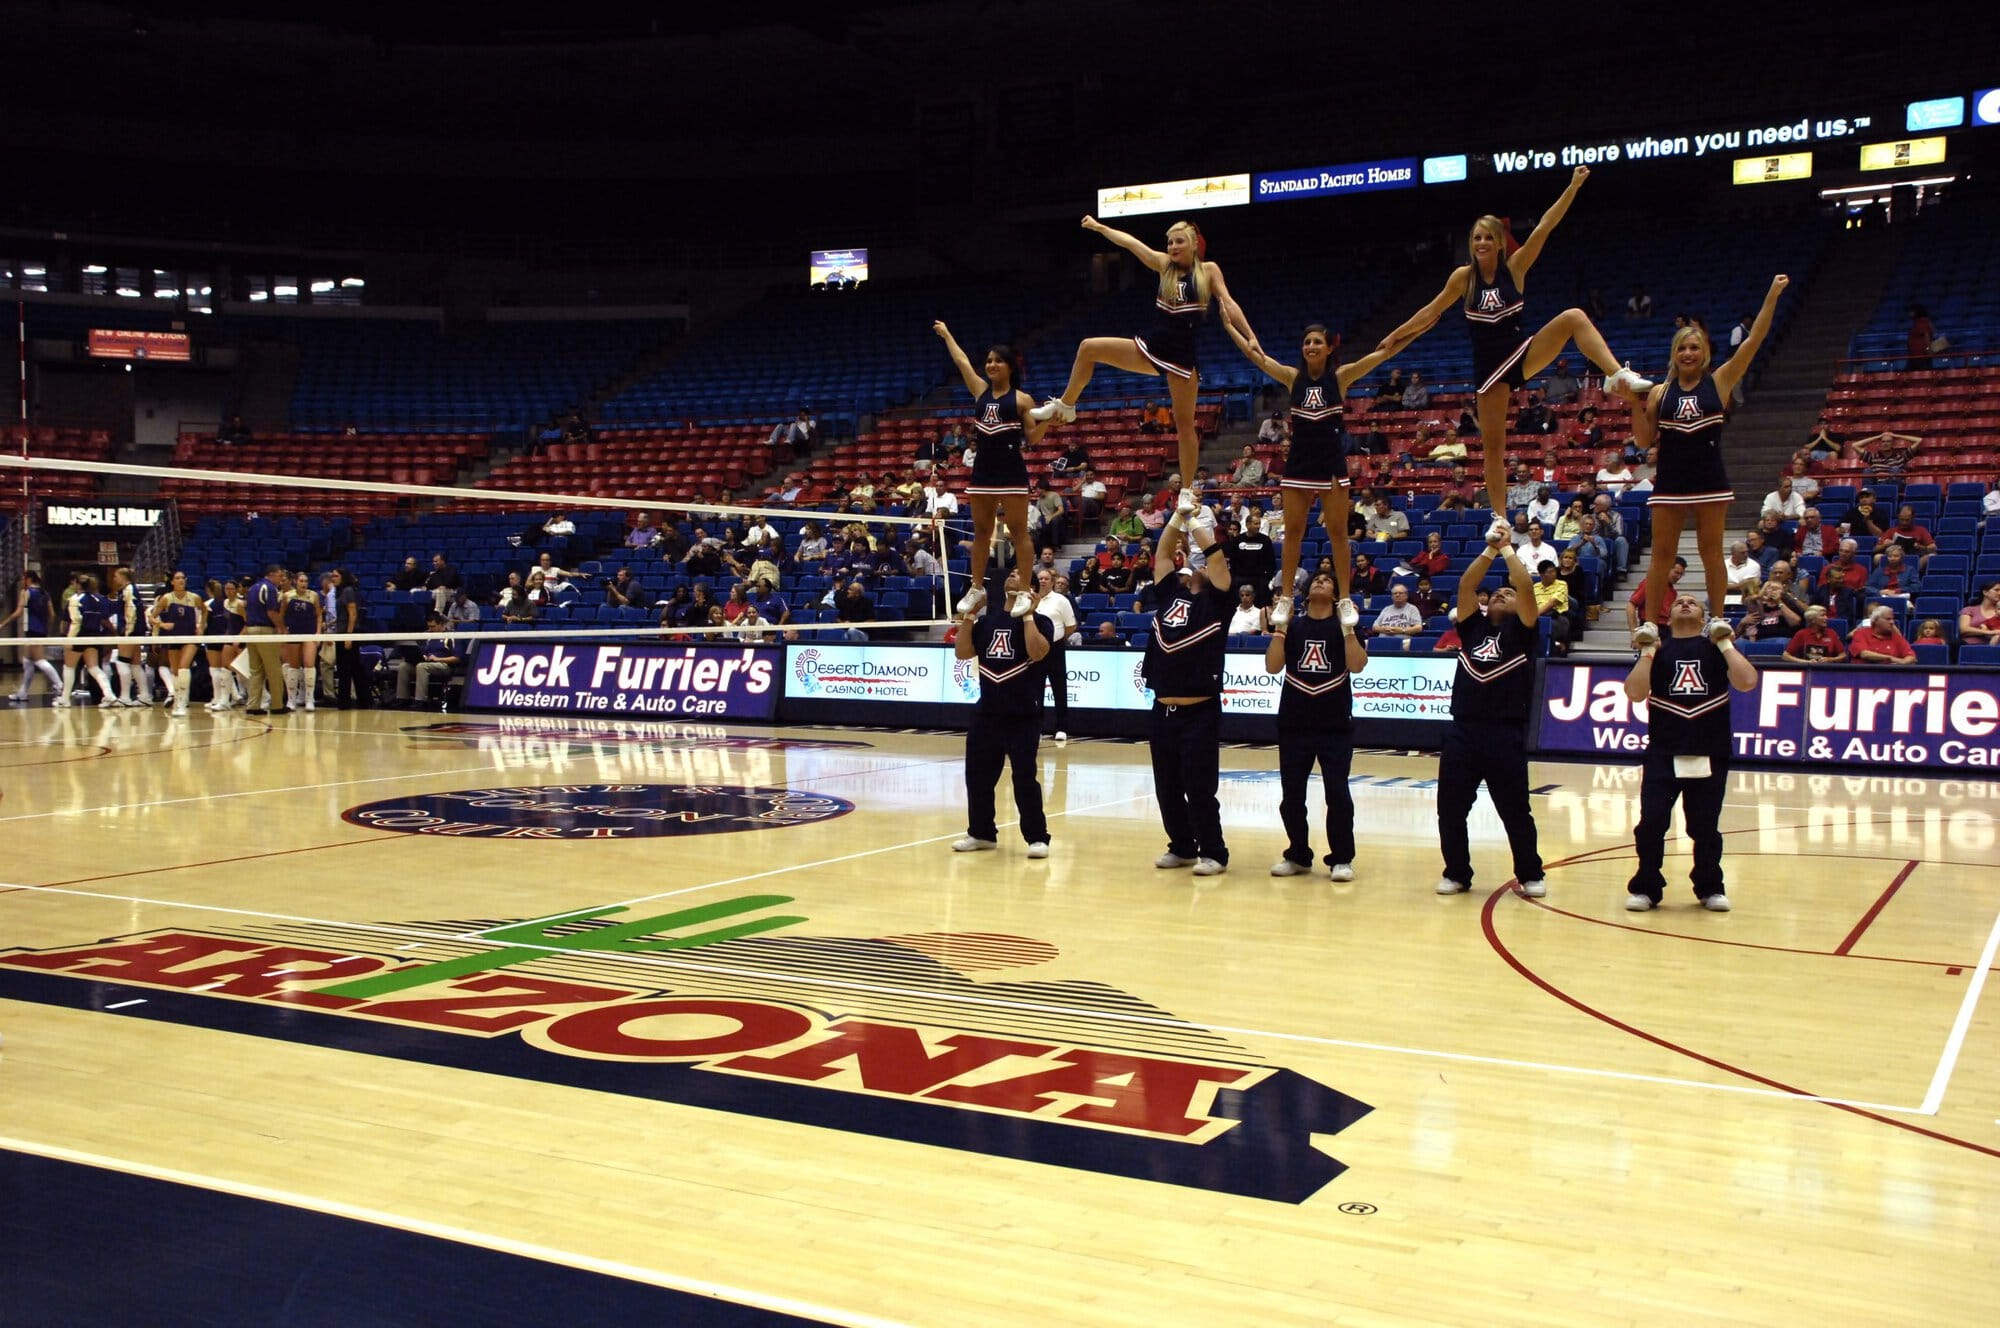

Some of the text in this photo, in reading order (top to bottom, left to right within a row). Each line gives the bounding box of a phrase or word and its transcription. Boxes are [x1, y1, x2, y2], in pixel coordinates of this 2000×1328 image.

[1493, 149, 1556, 173] We're
[1561, 145, 1620, 170] there
[1625, 136, 1689, 159] when
[1695, 131, 1740, 156] you
[1747, 118, 1809, 146] need
[1259, 177, 1319, 195] STANDARD
[1320, 173, 1364, 189] PACIFIC
[1367, 167, 1411, 184] HOMES
[1480, 288, 1504, 311] A
[1302, 386, 1327, 409] A
[1675, 395, 1703, 420] A
[982, 403, 1002, 425] A
[48, 507, 162, 527] MUSCLE MILK
[1162, 598, 1192, 628] A
[986, 628, 1015, 660] A
[1298, 640, 1331, 673] A
[1471, 635, 1502, 662] A
[477, 644, 773, 694] Jack Furrier's
[807, 660, 929, 678] DESERT DIAMOND
[1669, 659, 1708, 696] A
[825, 685, 909, 697] CASINO HOTEL
[1352, 675, 1453, 692] ESERT DIAM
[498, 689, 727, 714] Western Tire & Auto Care
[1232, 698, 1273, 709] HOTEL
[1363, 702, 1417, 713] CASINO
[1758, 671, 2000, 736] Furrie
[1733, 732, 2000, 766] Tire & Auto Car
[357, 809, 636, 839] COURT
